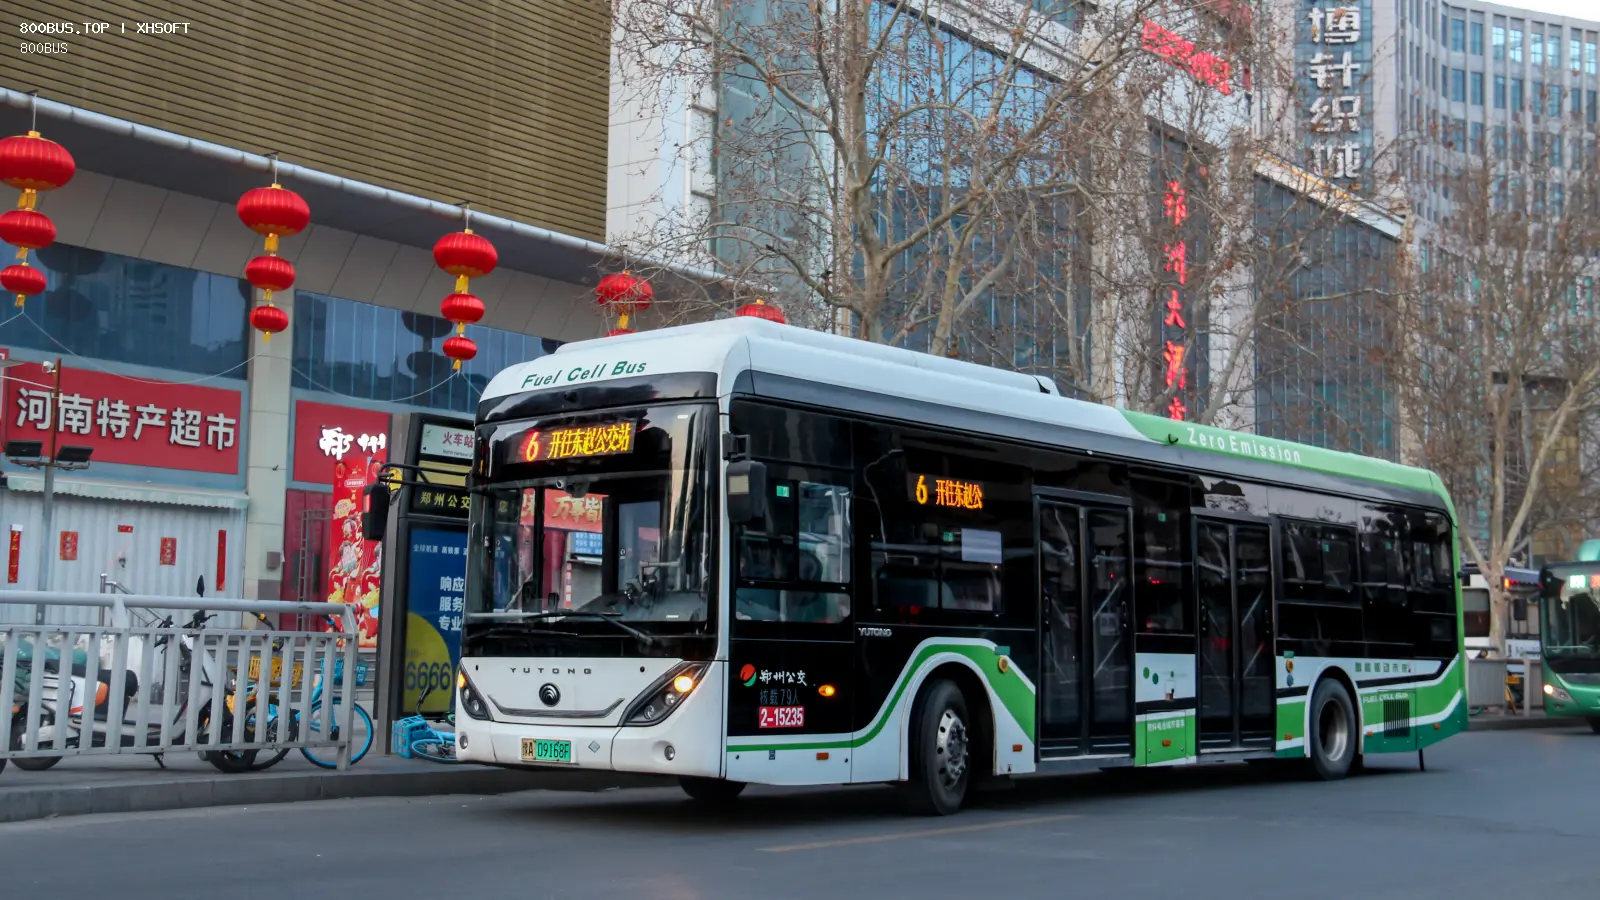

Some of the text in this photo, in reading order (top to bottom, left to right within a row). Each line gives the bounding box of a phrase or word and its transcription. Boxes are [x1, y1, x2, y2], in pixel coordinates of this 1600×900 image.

[521, 360, 647, 389] Fuel Cell Bus
[16, 387, 237, 451] 河南特产超市
[319, 425, 387, 460] 郑州
[442, 431, 474, 448] 火车站
[525, 421, 632, 461] 6 开往东赵公交站
[1186, 427, 1301, 464] Zero Emission
[420, 491, 470, 509] 郑州公交
[915, 475, 928, 505] 6
[552, 495, 603, 524] 万事皆
[440, 576, 465, 592] 响应
[439, 596, 464, 612] 服务
[858, 627, 892, 637] YUTONG
[405, 661, 451, 691] 6666
[510, 667, 592, 675] YUTONG
[759, 669, 808, 687] 郑州公交
[760, 707, 803, 726] 2-15235
